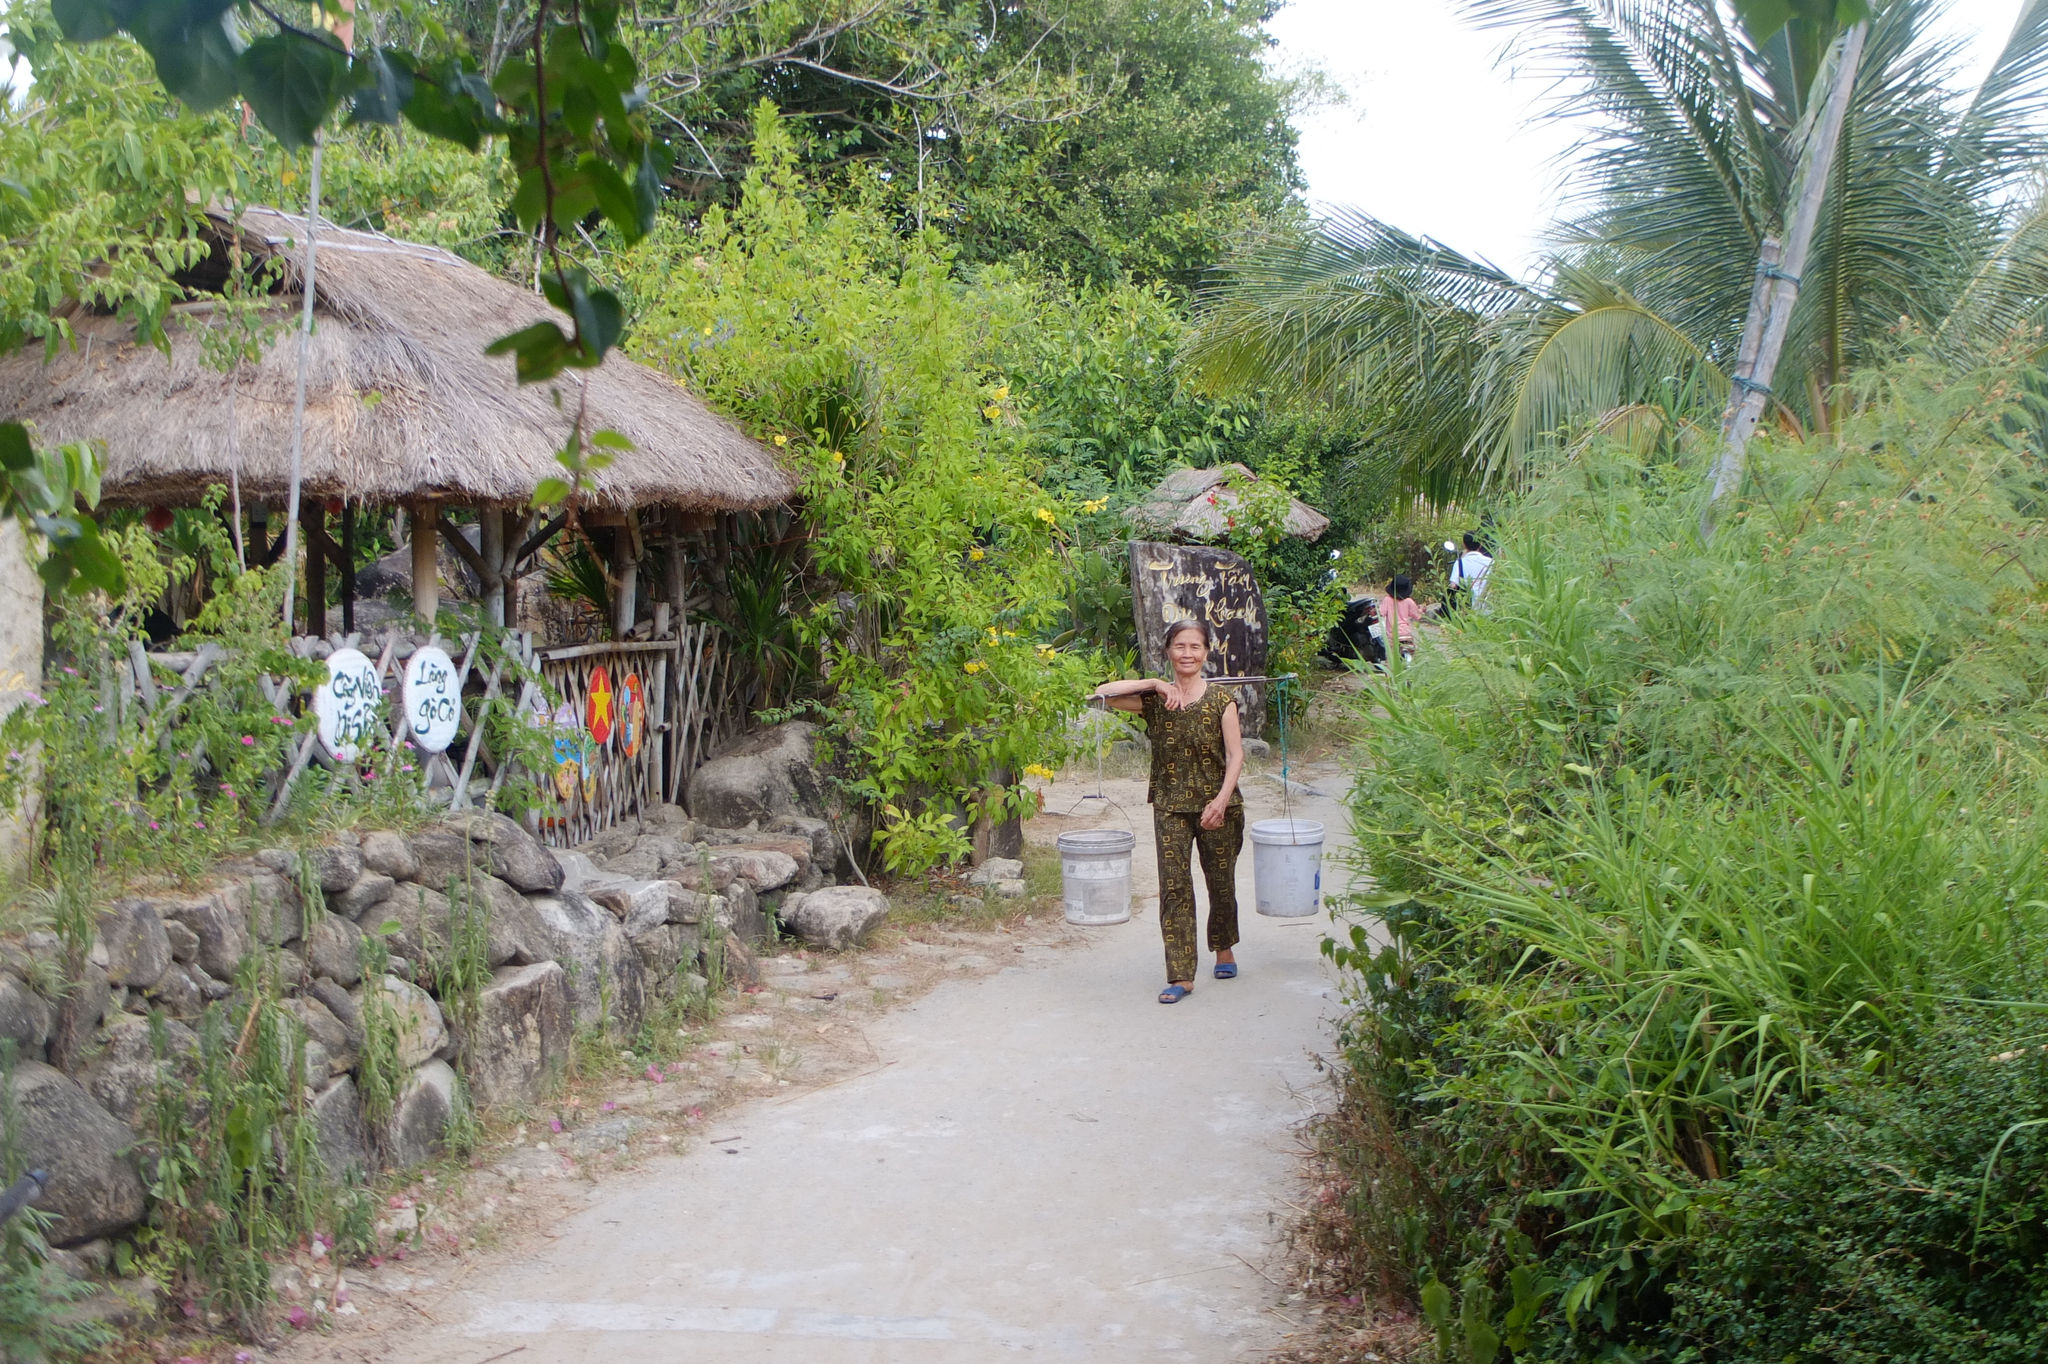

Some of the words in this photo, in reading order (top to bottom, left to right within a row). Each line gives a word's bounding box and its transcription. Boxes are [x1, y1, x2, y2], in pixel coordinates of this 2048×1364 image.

[1149, 561, 1210, 597] Trung
[1204, 595, 1258, 628] Khách
[416, 660, 447, 694] Làng
